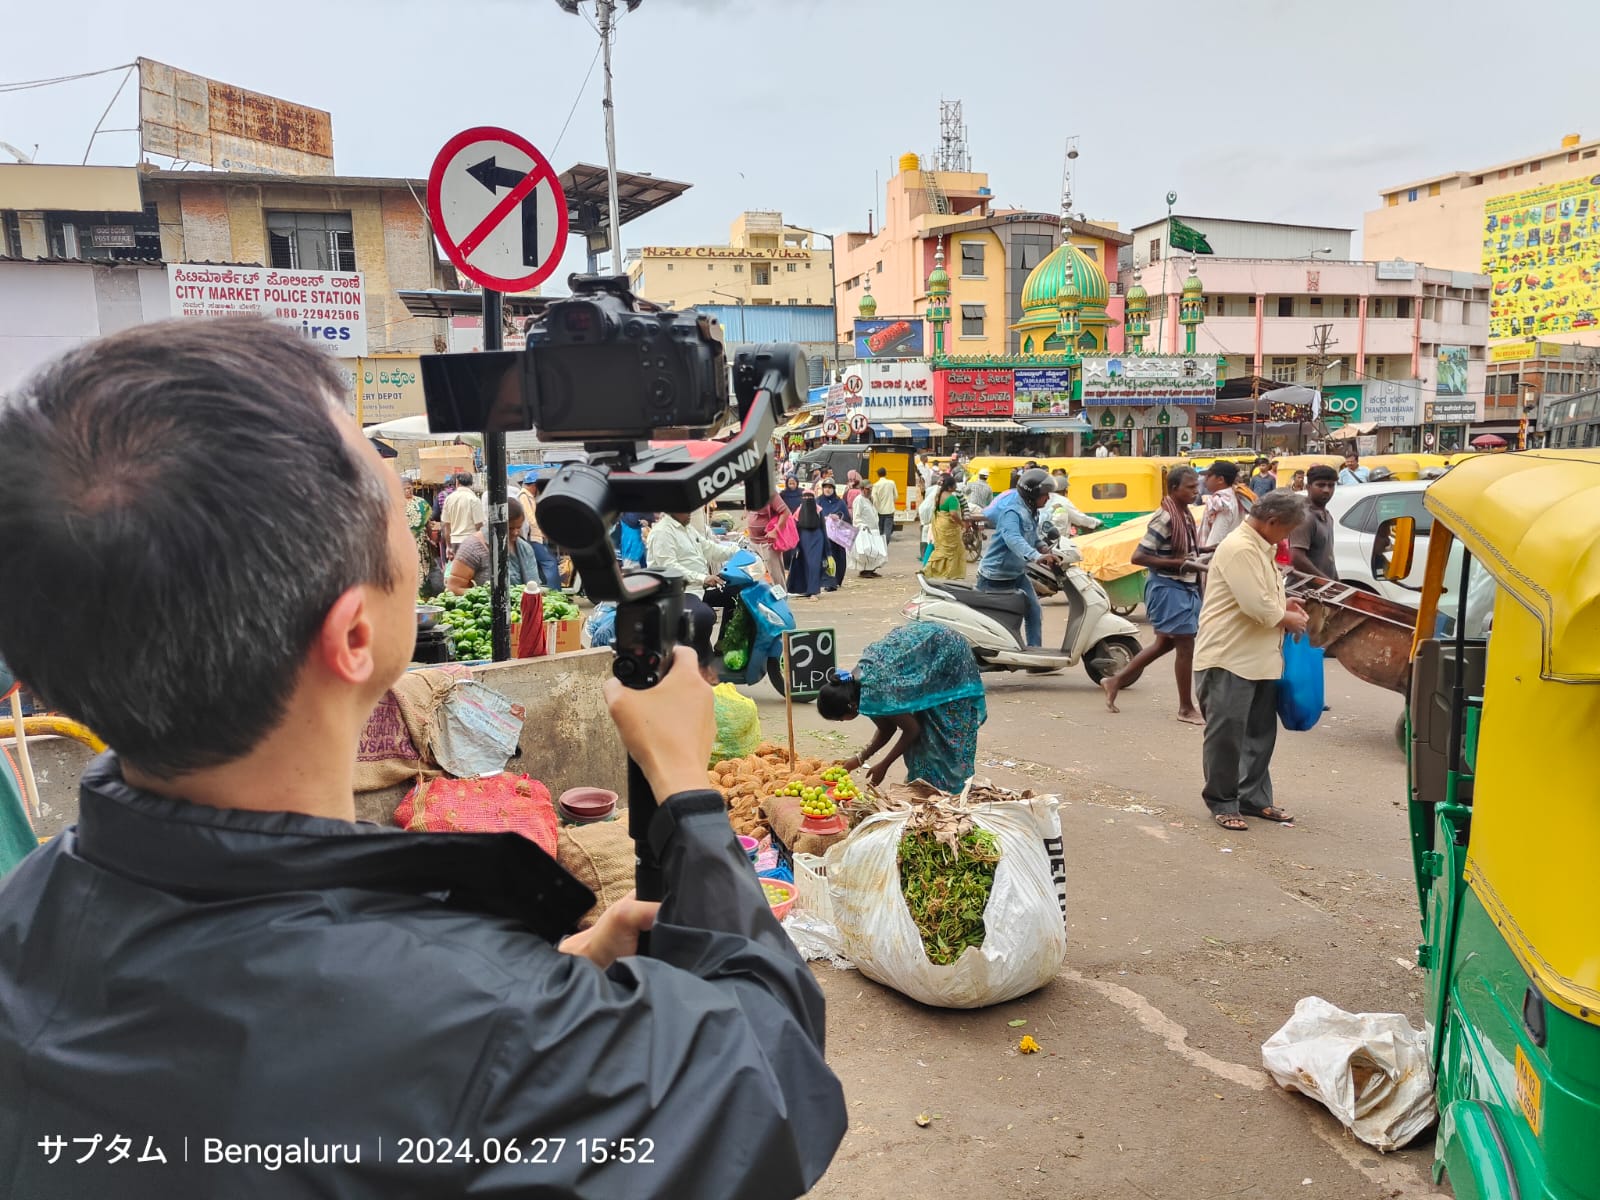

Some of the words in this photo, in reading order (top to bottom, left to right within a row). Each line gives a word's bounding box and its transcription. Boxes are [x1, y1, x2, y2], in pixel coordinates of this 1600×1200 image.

[644, 247, 691, 257] Hotel
[695, 247, 765, 258] Chandra
[767, 248, 811, 258] Vihar
[175, 285, 205, 299] CITY
[208, 287, 261, 302] MARKET
[264, 288, 308, 303] POLICE
[310, 290, 361, 305] STATION
[183, 309, 204, 317] HELP
[275, 307, 360, 321] 080-22942506
[377, 392, 403, 400] DEPOT
[864, 396, 897, 408] BALAJI
[899, 395, 933, 407] SWEETS
[948, 390, 977, 403] Delhi
[978, 391, 1011, 403] Sweets
[697, 441, 760, 499] RONIN
[789, 632, 833, 668] 50
[359, 739, 395, 753] VSAR
